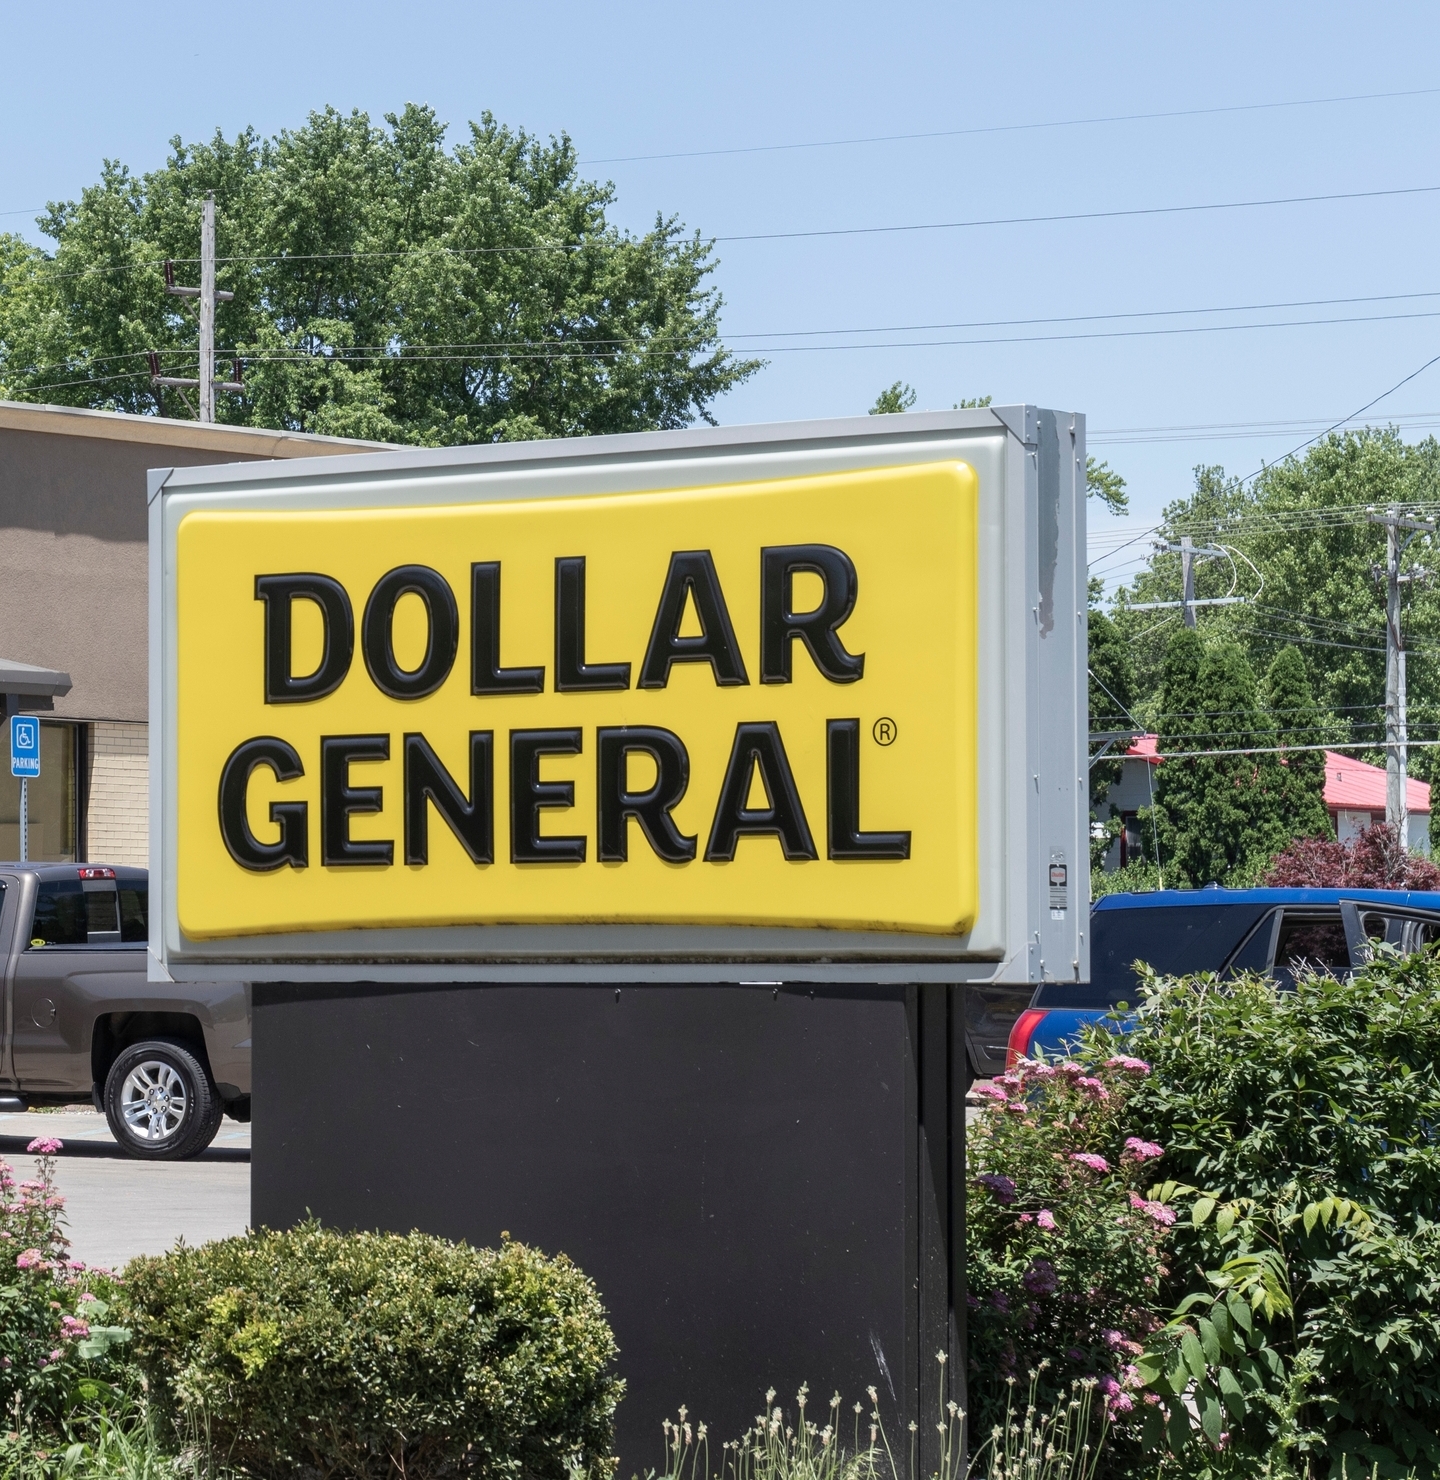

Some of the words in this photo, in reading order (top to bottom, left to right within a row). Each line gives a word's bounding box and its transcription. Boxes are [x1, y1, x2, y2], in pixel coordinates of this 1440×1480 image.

[252, 543, 866, 706] DOLLAR
[13, 757, 39, 769] PARKING
[216, 716, 913, 873] GENERAL
